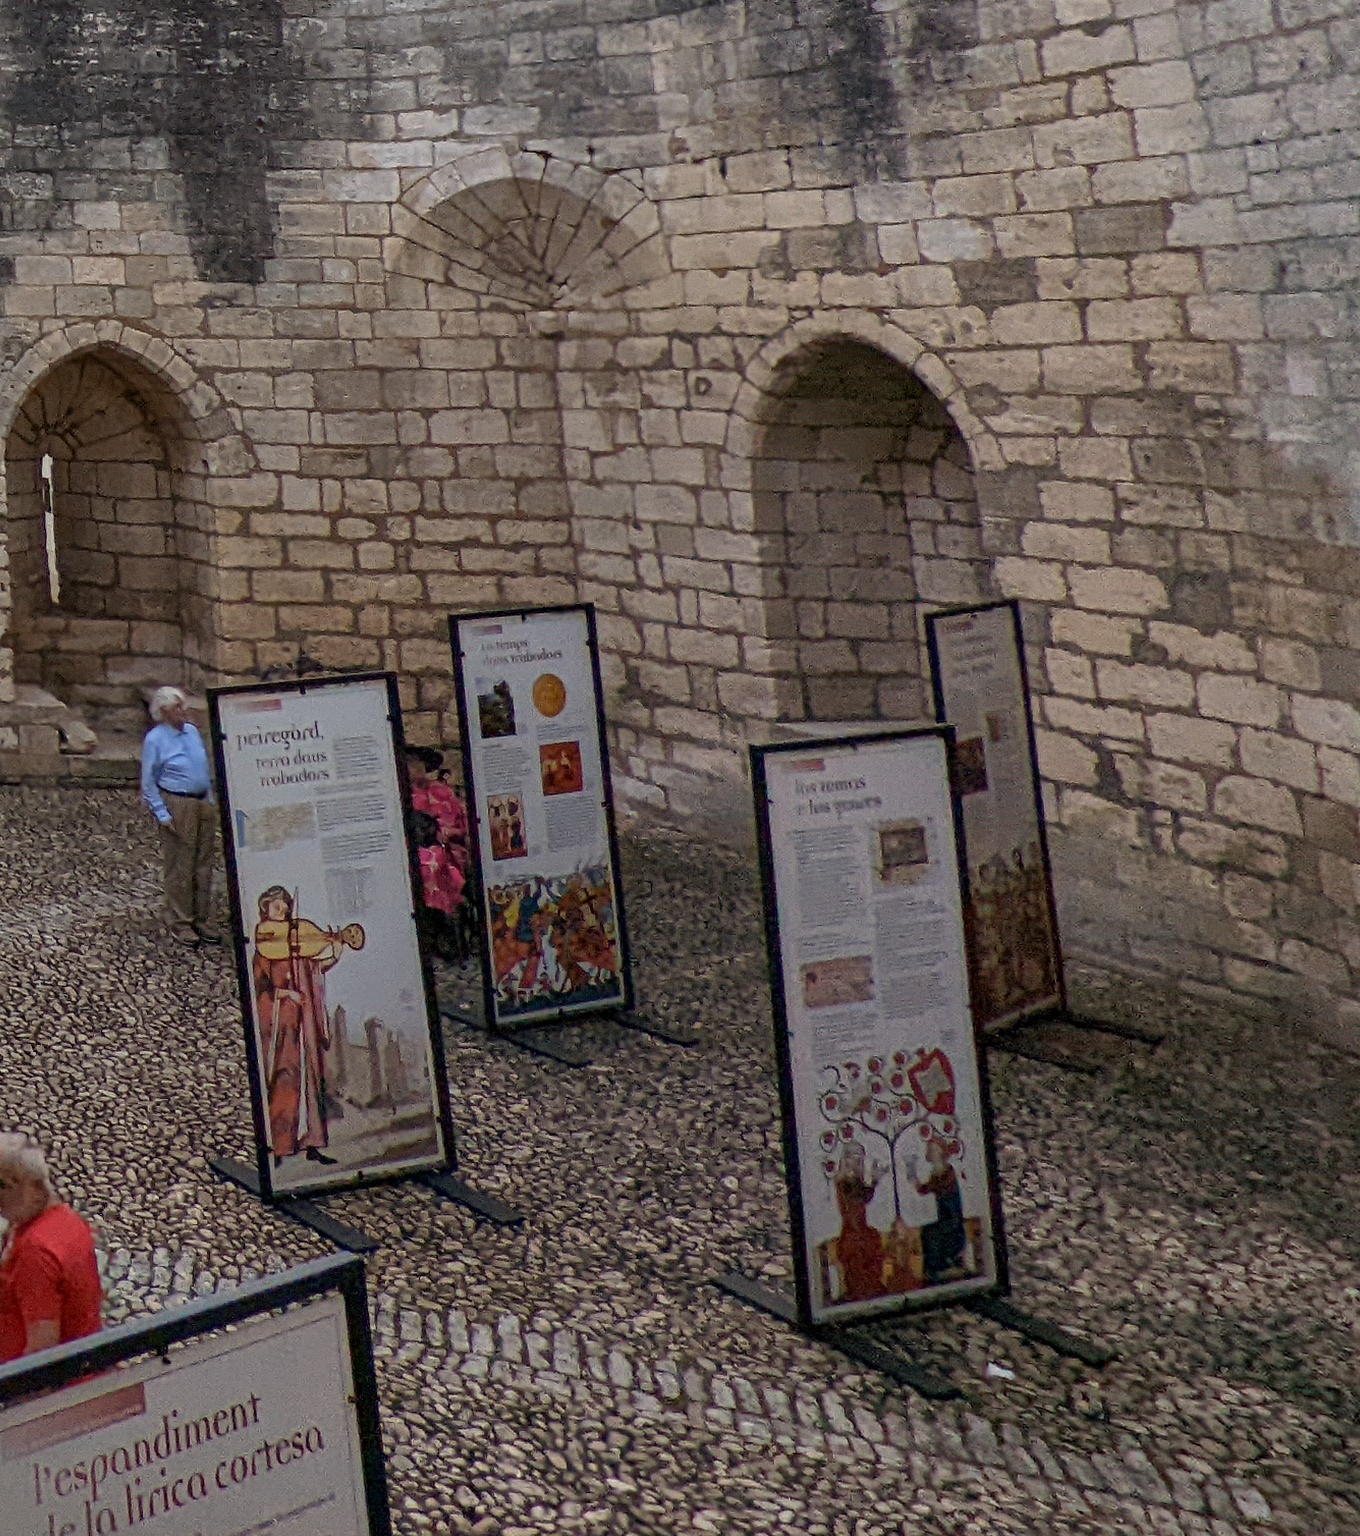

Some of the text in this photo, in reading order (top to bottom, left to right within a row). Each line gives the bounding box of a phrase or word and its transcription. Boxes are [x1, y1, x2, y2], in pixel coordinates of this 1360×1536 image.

[260, 767, 330, 787] trobadors
[293, 749, 328, 766] daus
[33, 1390, 263, 1506] l'espandiment
[125, 1465, 209, 1527] lirica
[214, 1424, 326, 1490] cortesa
